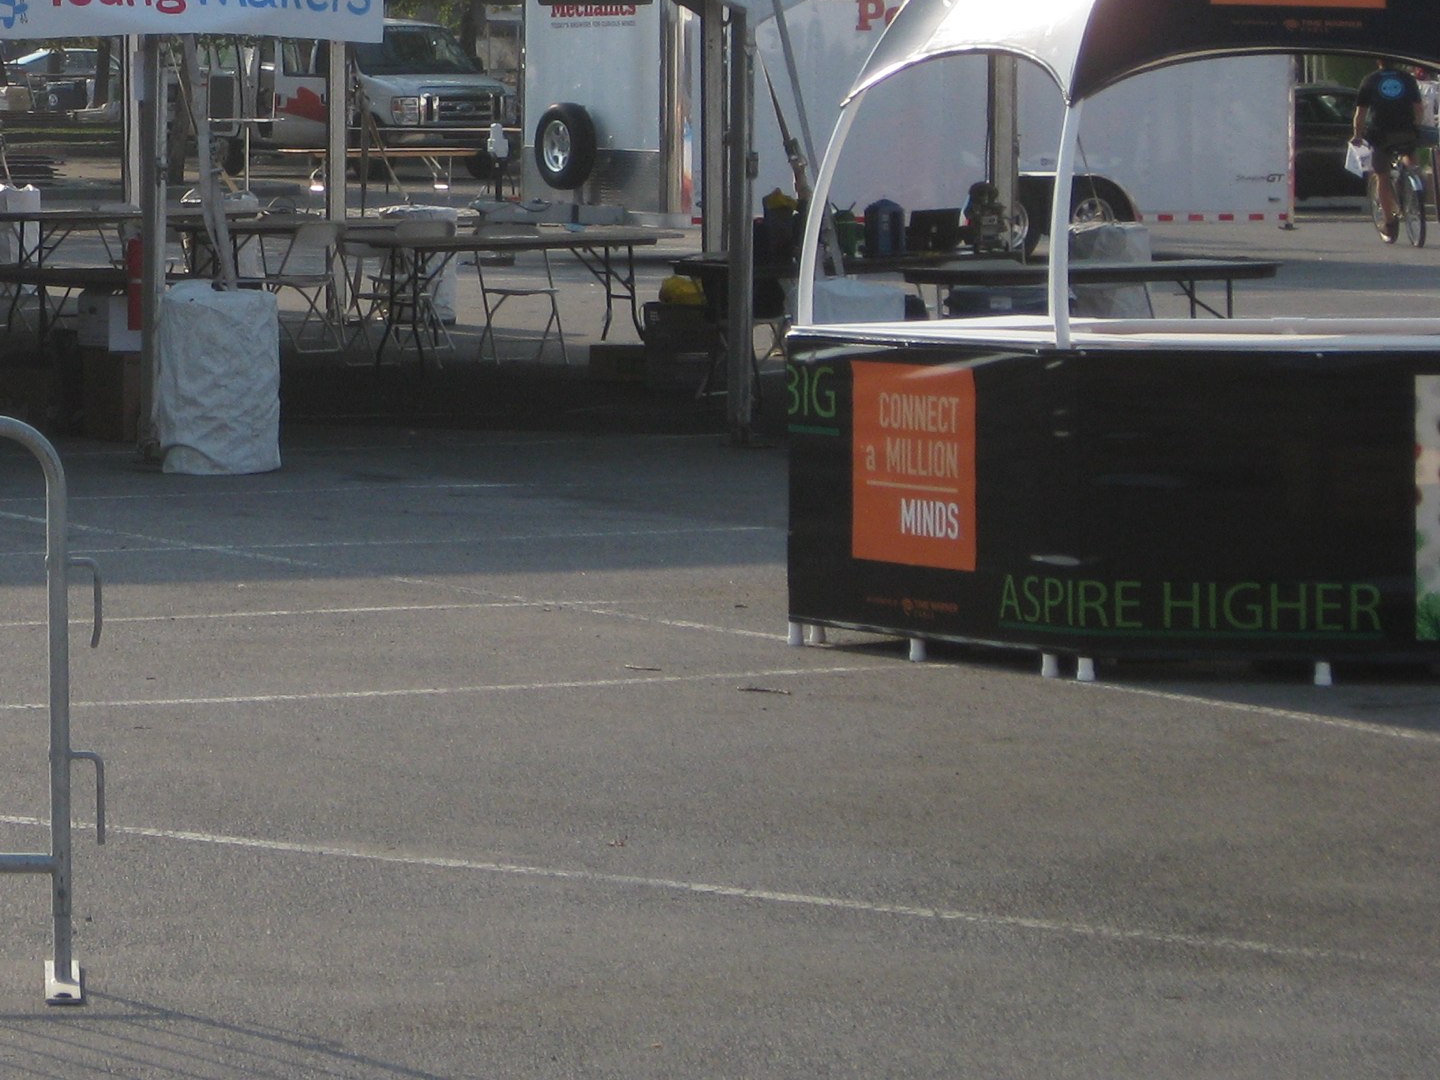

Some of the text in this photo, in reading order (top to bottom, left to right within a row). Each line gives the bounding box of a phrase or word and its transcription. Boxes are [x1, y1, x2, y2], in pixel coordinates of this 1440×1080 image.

[879, 391, 959, 433] CONNECT
[865, 436, 959, 478] a MILLION
[900, 497, 959, 540] MINDS
[1000, 574, 1383, 631] ASPIRE HIGHER
